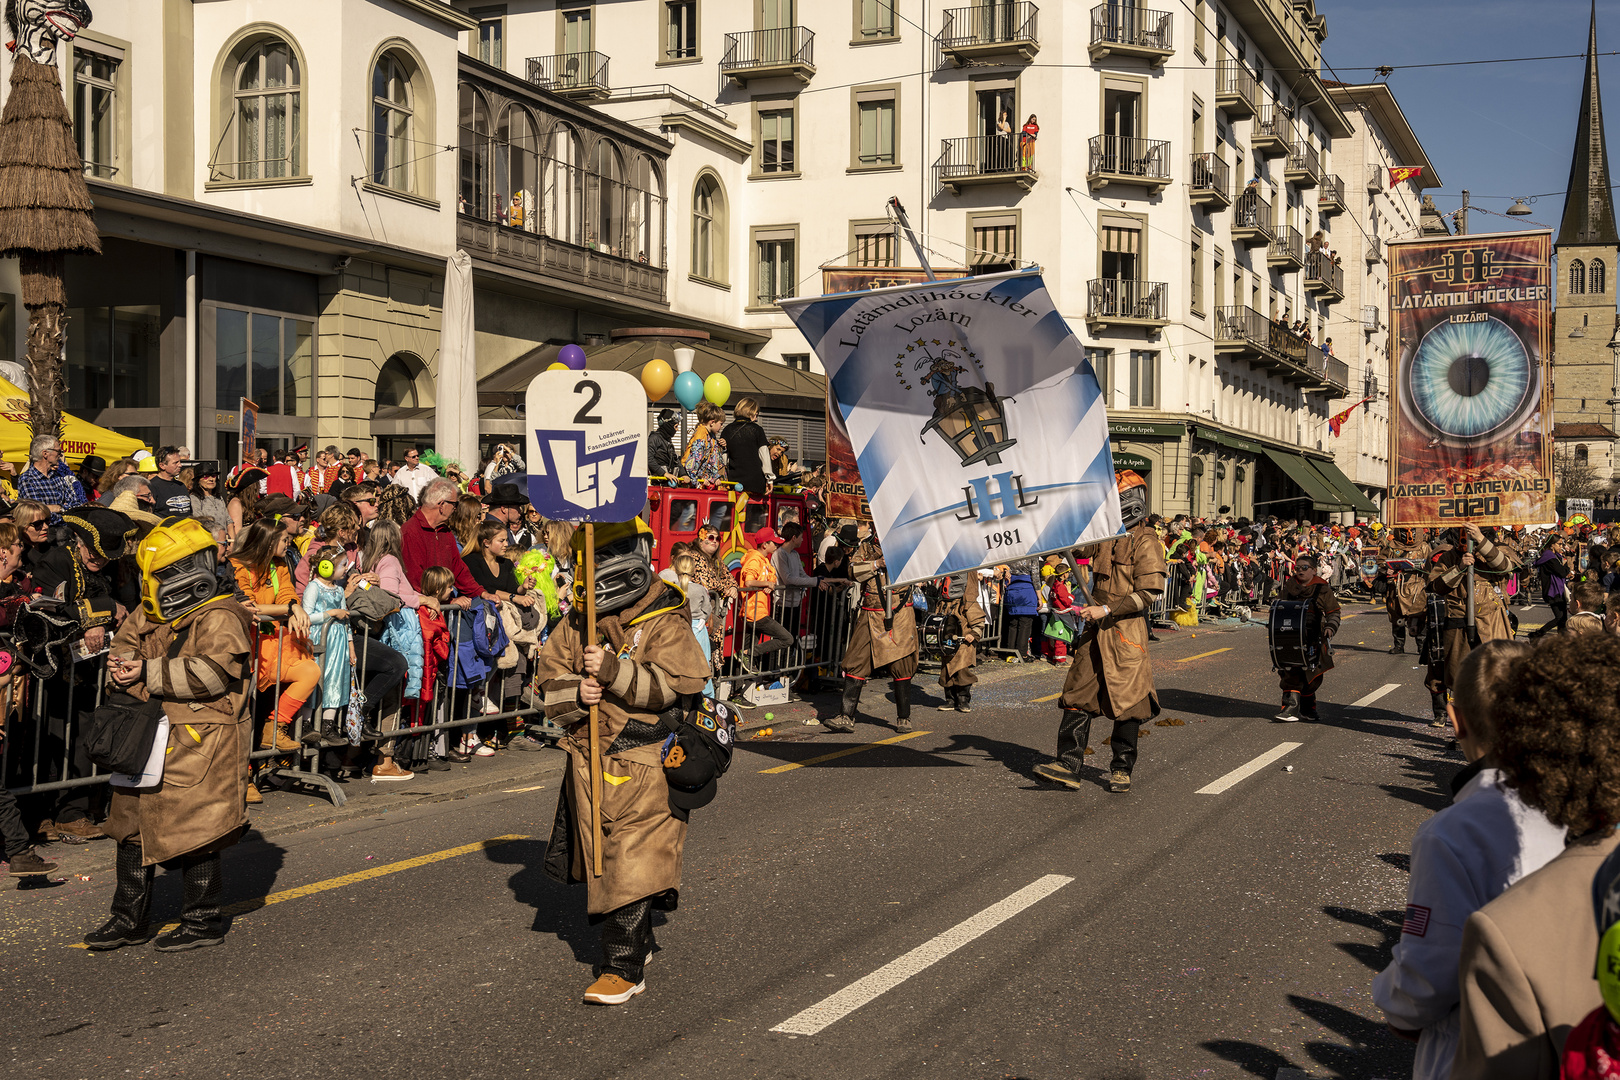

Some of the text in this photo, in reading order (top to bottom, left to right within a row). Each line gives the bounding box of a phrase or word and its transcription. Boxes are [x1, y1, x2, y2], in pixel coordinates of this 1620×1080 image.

[1391, 286, 1548, 310] LATÄRNDLIHÖCKLER
[839, 290, 1037, 349] Latärndlihöckler
[894, 308, 971, 334] Lozärn
[1450, 311, 1488, 323] LOZÄRN
[573, 380, 602, 424] 2
[216, 414, 234, 424] BAR
[1137, 426, 1154, 434] Arpels
[587, 432, 641, 452] Fasnachtskomitee
[598, 429, 625, 441] Lozärner
[1438, 496, 1500, 518] 2020
[984, 528, 1022, 550] 1981
